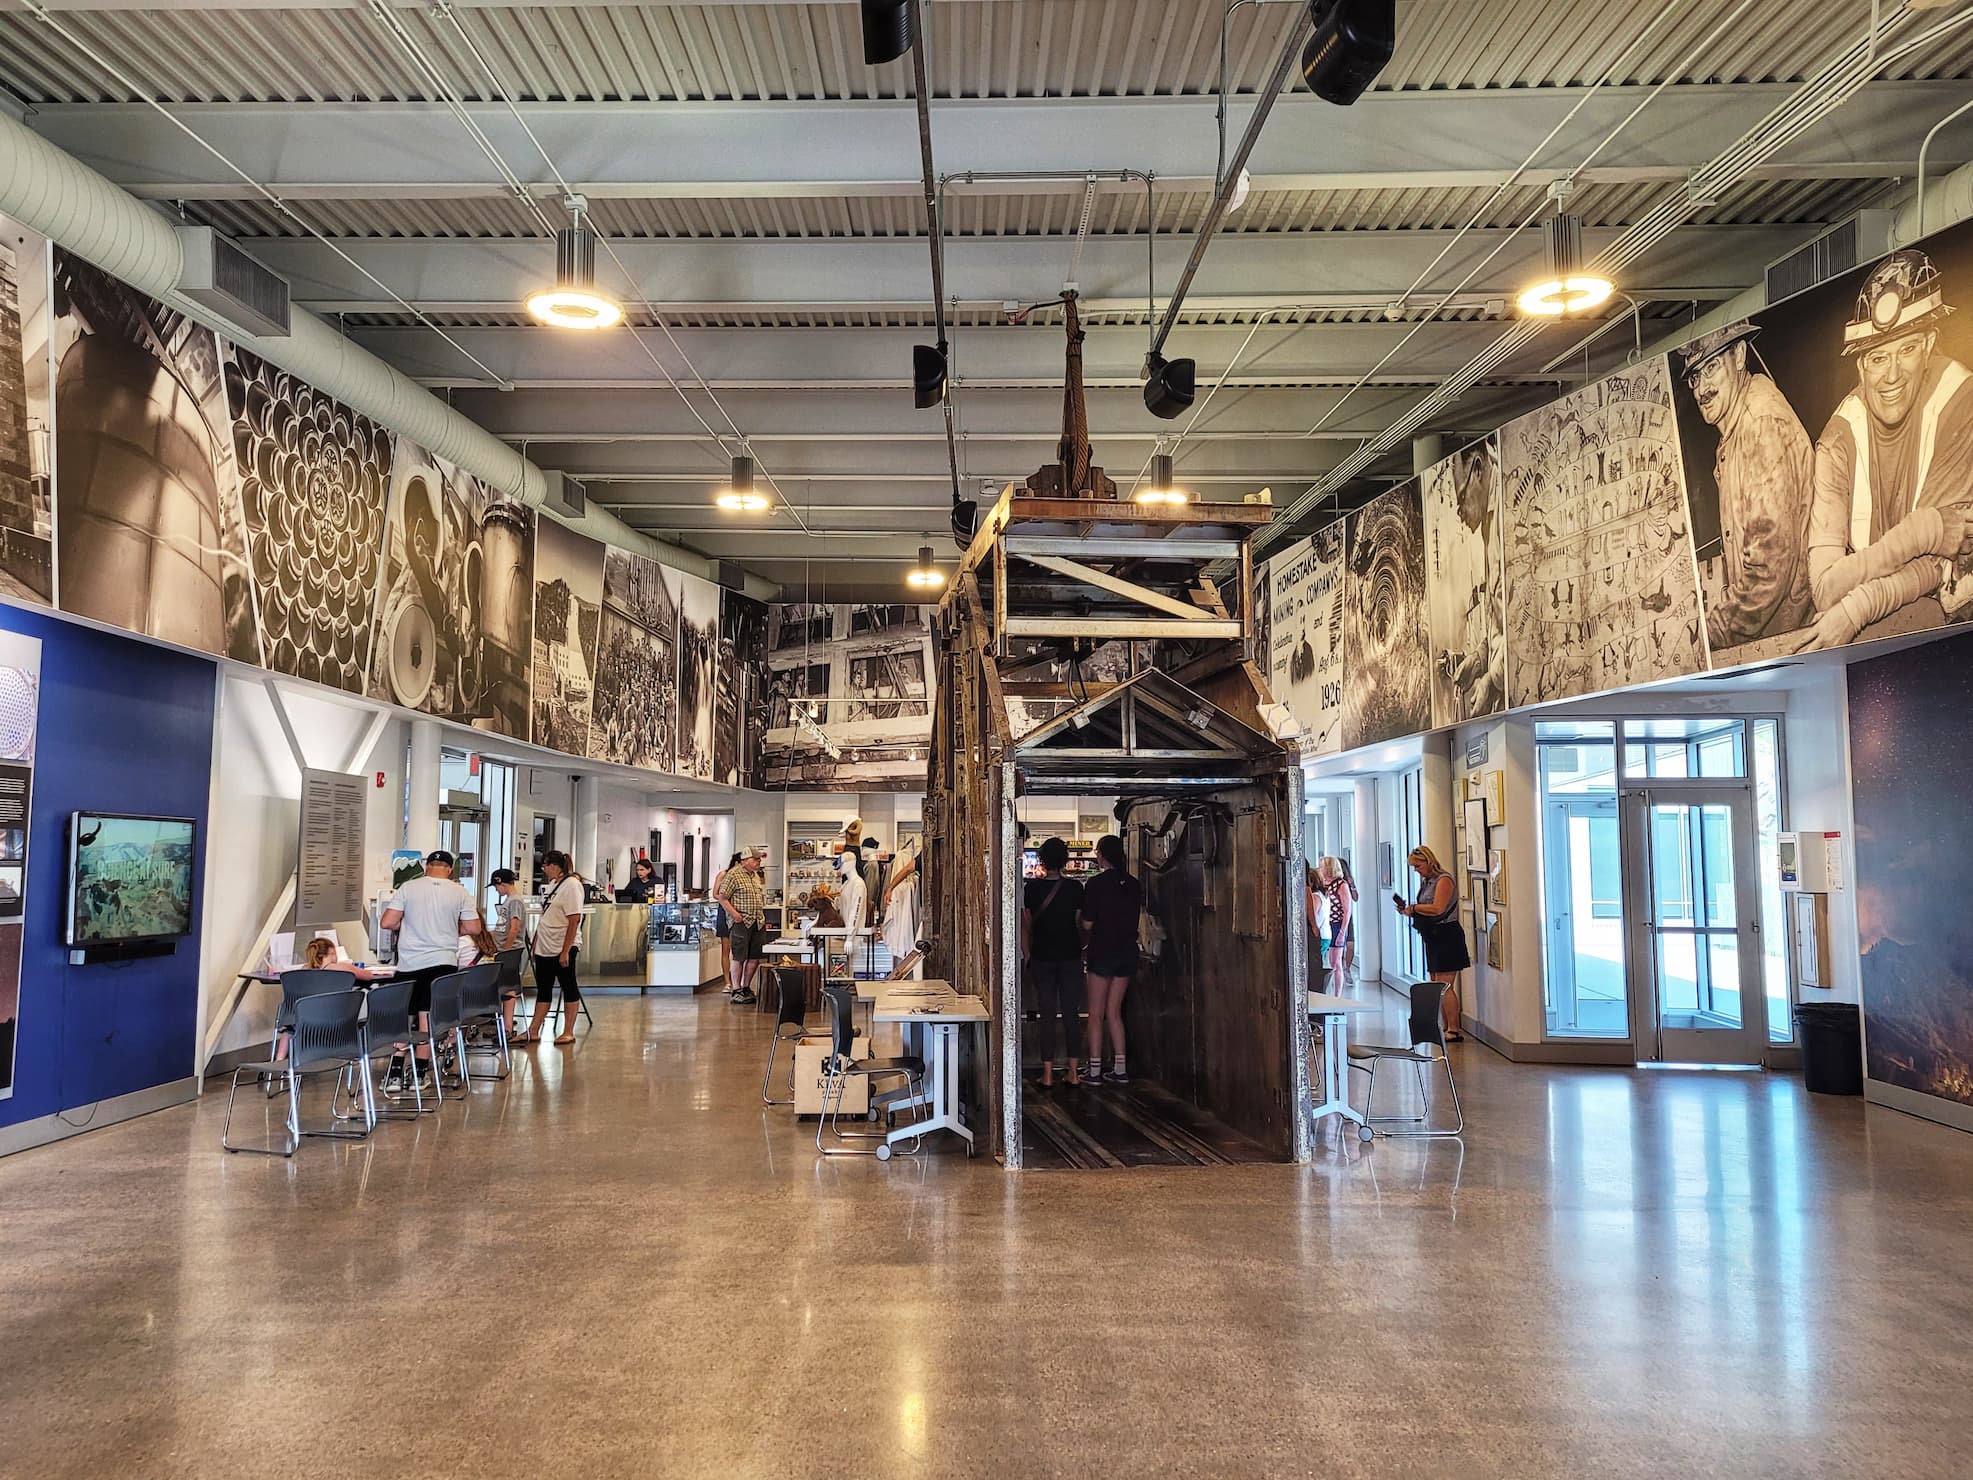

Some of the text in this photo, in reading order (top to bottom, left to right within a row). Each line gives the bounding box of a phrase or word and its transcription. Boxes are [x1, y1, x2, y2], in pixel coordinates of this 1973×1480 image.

[1277, 553, 1317, 596] HOMESTAKE
[1273, 597, 1294, 626] MINING
[1321, 679, 1341, 711] 1926
[151, 859, 176, 880] SURF
